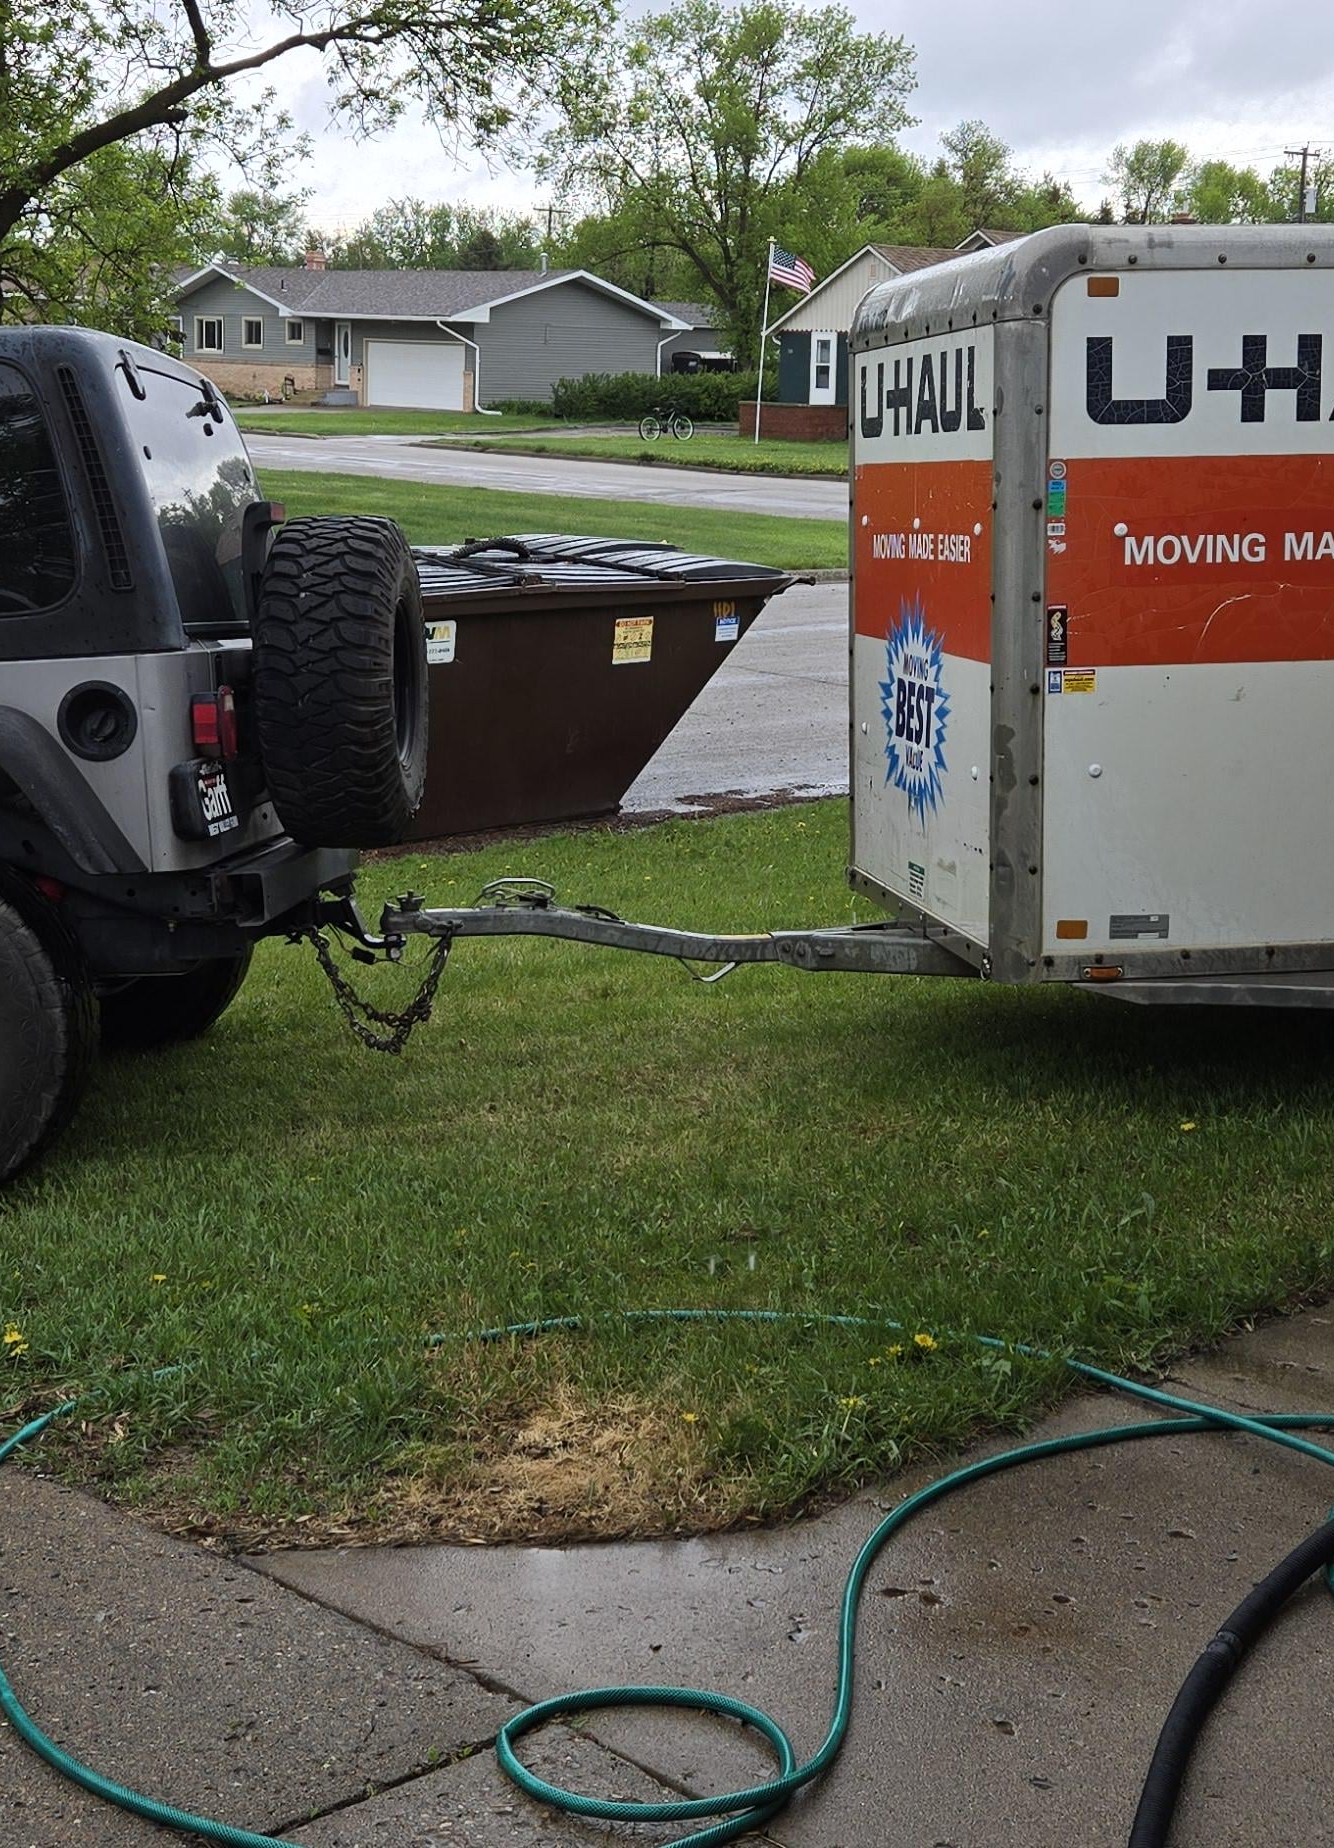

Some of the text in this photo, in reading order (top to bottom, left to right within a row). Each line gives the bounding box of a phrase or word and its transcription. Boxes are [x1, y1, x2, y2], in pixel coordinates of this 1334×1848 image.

[861, 346, 986, 438] U-HAUL
[873, 532, 971, 563] MOVING MADE EASIER
[1123, 533, 1267, 566] MOVING
[903, 652, 929, 681] MOVING
[895, 677, 935, 749] BEST
